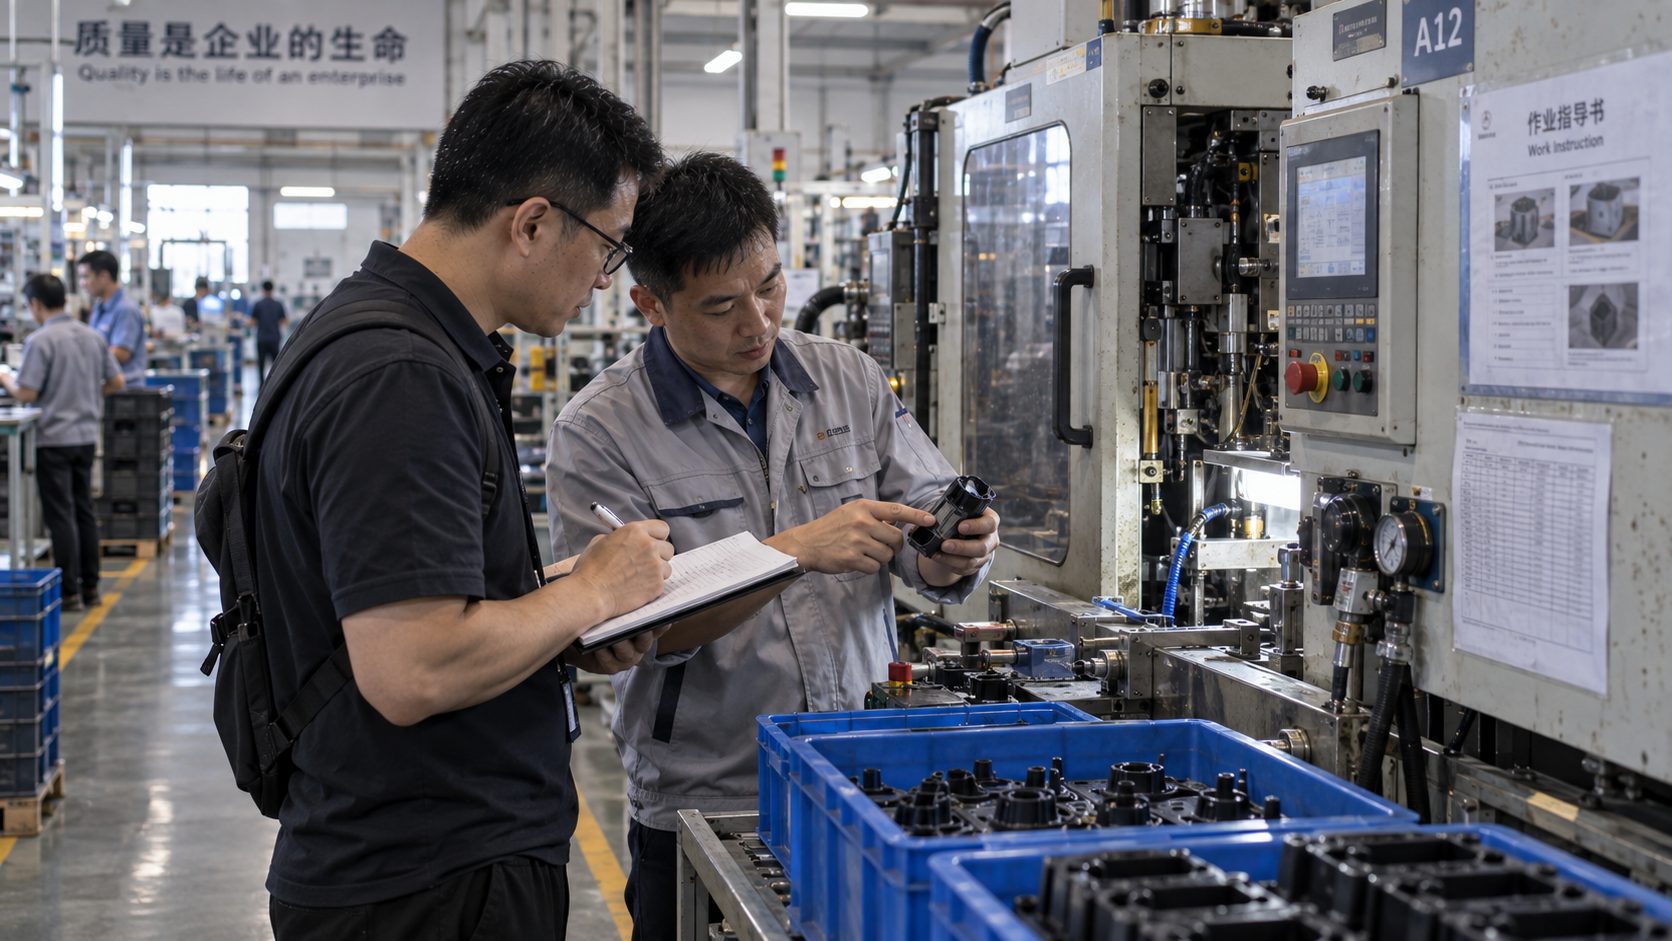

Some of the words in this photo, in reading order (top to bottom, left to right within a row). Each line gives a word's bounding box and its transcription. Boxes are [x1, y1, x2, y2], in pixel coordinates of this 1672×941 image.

[74, 20, 408, 63] 质量是企业的生命
[1413, 6, 1463, 57] A12
[78, 63, 149, 85] Quality
[155, 64, 171, 82] is
[178, 64, 209, 83] the
[215, 64, 247, 84] life
[252, 67, 273, 84] of
[279, 70, 302, 85] an
[308, 70, 406, 88] enterprise
[1527, 97, 1605, 136] 作业指导书
[1527, 141, 1551, 157] Work
[1553, 134, 1604, 154] Instruction
